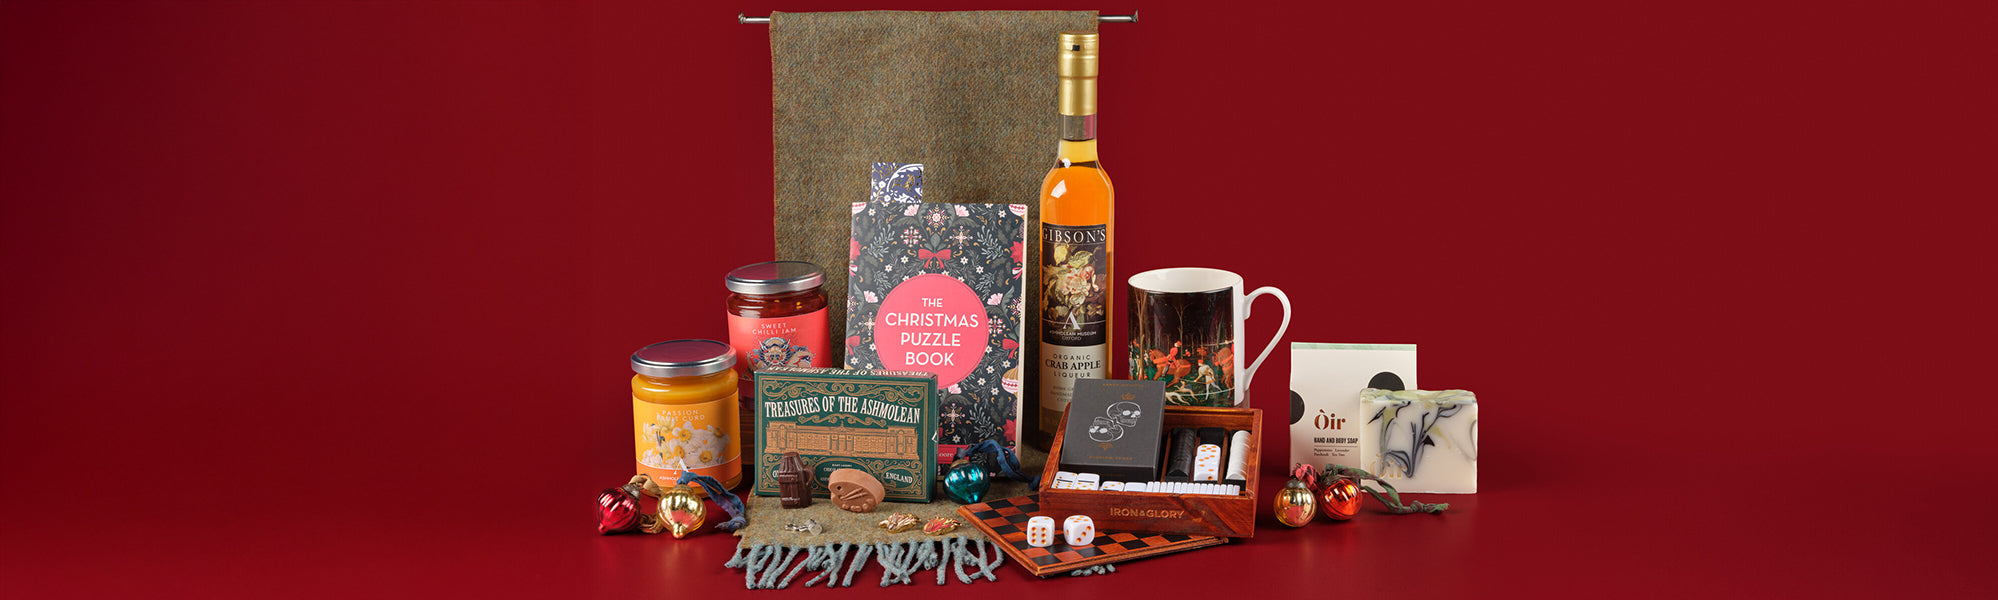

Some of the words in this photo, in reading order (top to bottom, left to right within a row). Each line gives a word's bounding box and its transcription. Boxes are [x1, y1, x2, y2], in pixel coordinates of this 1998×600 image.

[1042, 228, 1106, 243] GIBSON'S
[921, 298, 943, 307] THE
[761, 322, 787, 330] SWEET
[885, 312, 979, 328] CHRISTMAS
[1062, 311, 1081, 330] A
[781, 327, 797, 335] JAM
[901, 332, 961, 347] PUZZLE
[905, 351, 954, 366] BOOK
[1053, 353, 1091, 361] ORGANIC
[1045, 358, 1069, 370] CRAB
[1070, 360, 1101, 370] APPLE
[764, 396, 821, 418] TREASURES
[822, 395, 836, 413] OF
[838, 396, 859, 413] THE
[860, 398, 921, 424] ASHMOLEAN
[681, 414, 705, 422] CURD
[1314, 408, 1346, 430] Òir
[885, 471, 913, 484] ENGLAND
[1110, 507, 1185, 519] IRON&GLORY
